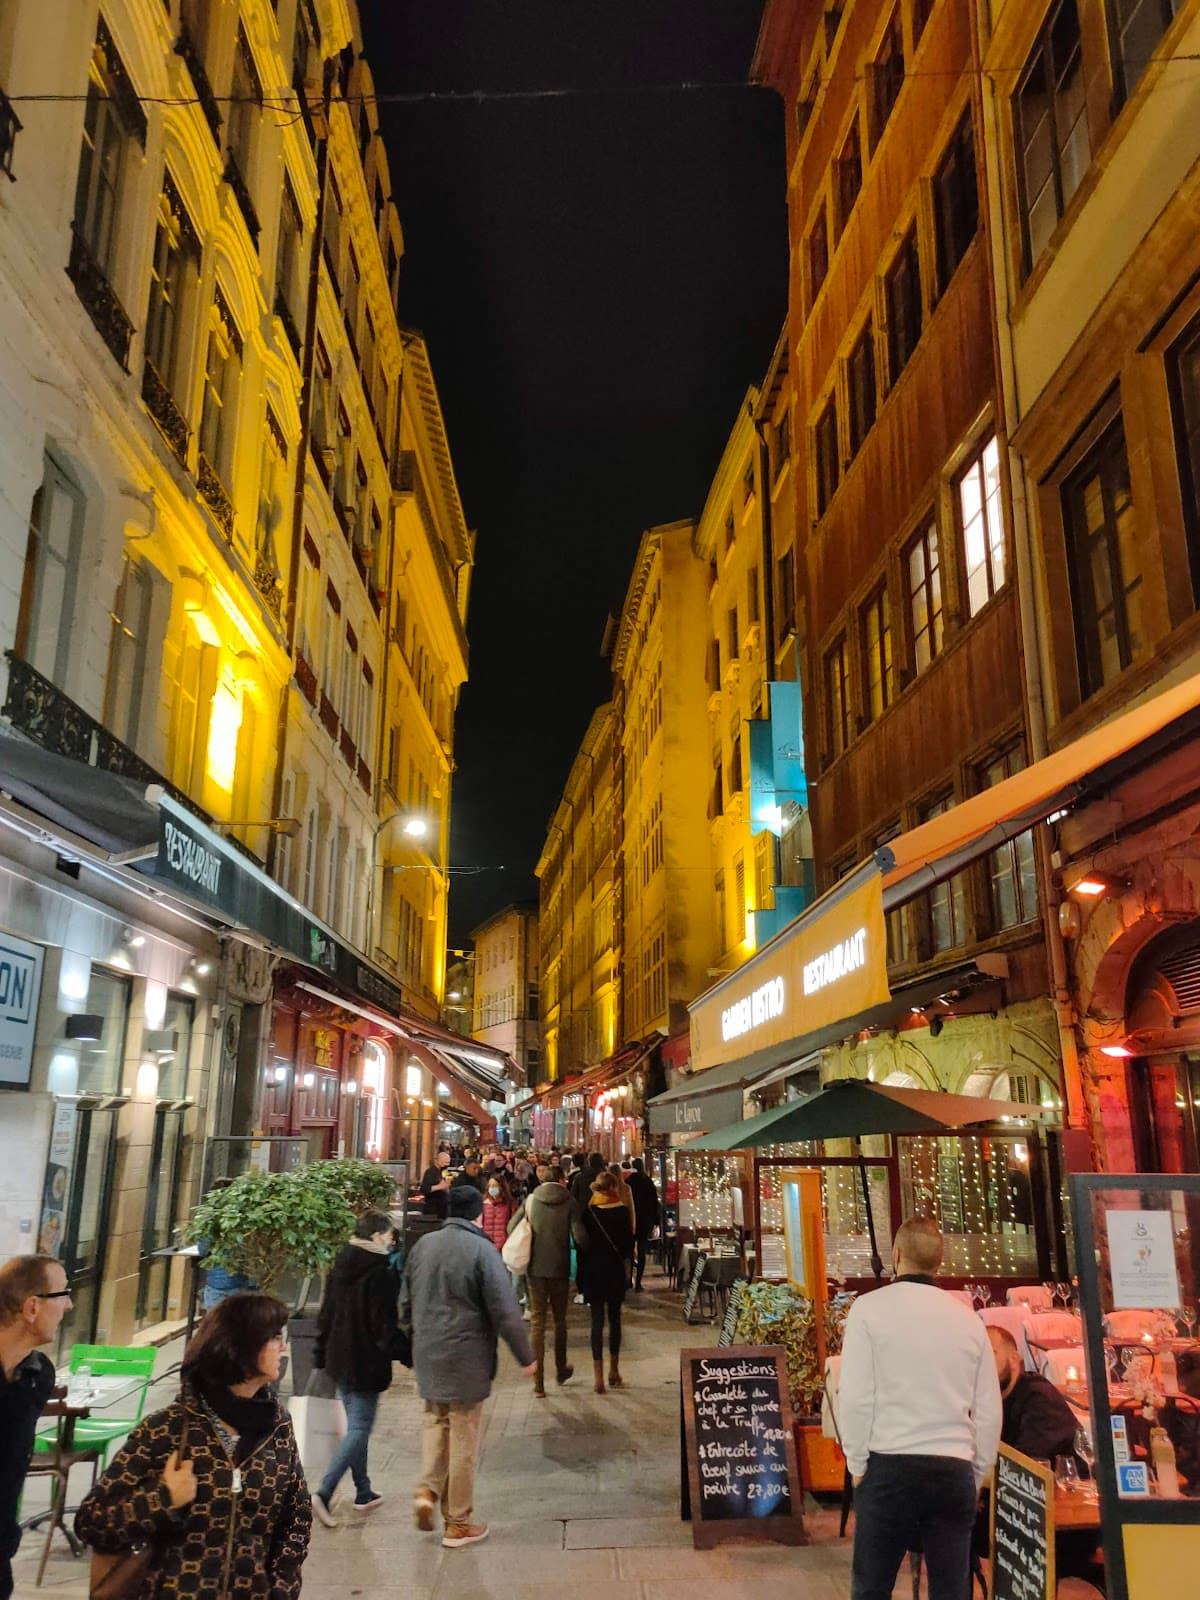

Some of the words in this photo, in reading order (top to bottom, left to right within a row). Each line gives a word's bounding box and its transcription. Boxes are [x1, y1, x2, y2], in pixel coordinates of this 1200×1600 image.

[165, 821, 221, 896] RESTAURANT
[803, 927, 867, 996] RESTAURANT
[752, 975, 784, 1029] BISTRO
[752, 1387, 769, 1398] du
[698, 1402, 717, 1420] chef
[722, 1402, 733, 1414] et
[734, 1405, 748, 1414] sa
[751, 1400, 779, 1416] purée
[716, 1416, 730, 1429] la
[730, 1415, 766, 1437] Truffe
[706, 1440, 757, 1459] Entrecôte
[763, 1442, 779, 1456] de
[735, 1464, 767, 1476] sauce
[770, 1463, 788, 1473] au
[703, 1482, 740, 1499] poivre
